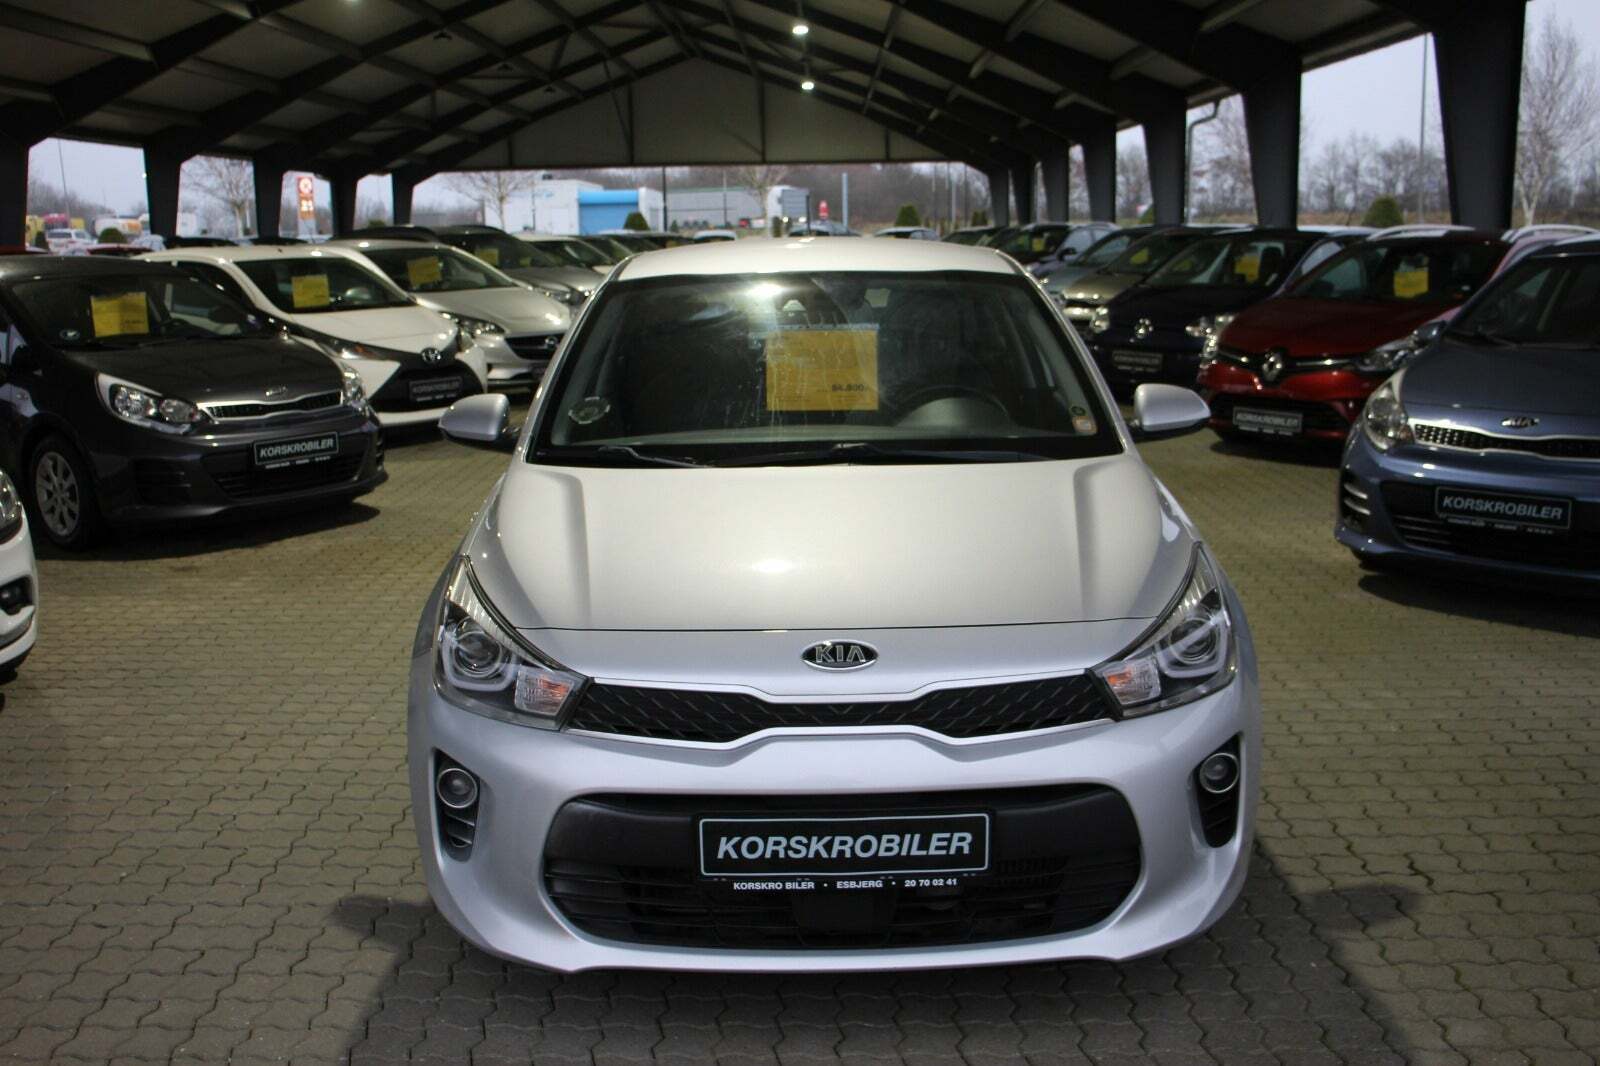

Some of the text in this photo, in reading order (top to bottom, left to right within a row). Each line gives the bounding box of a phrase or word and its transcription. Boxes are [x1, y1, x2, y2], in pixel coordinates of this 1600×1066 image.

[259, 438, 334, 458] KORSKROBILER
[1442, 495, 1564, 520] KORSKROBILER
[815, 644, 867, 663] KIA
[716, 831, 974, 860] KORSKROBILER
[733, 877, 958, 890] KORSKRO BILER ESBJERG 20 70 02 41
